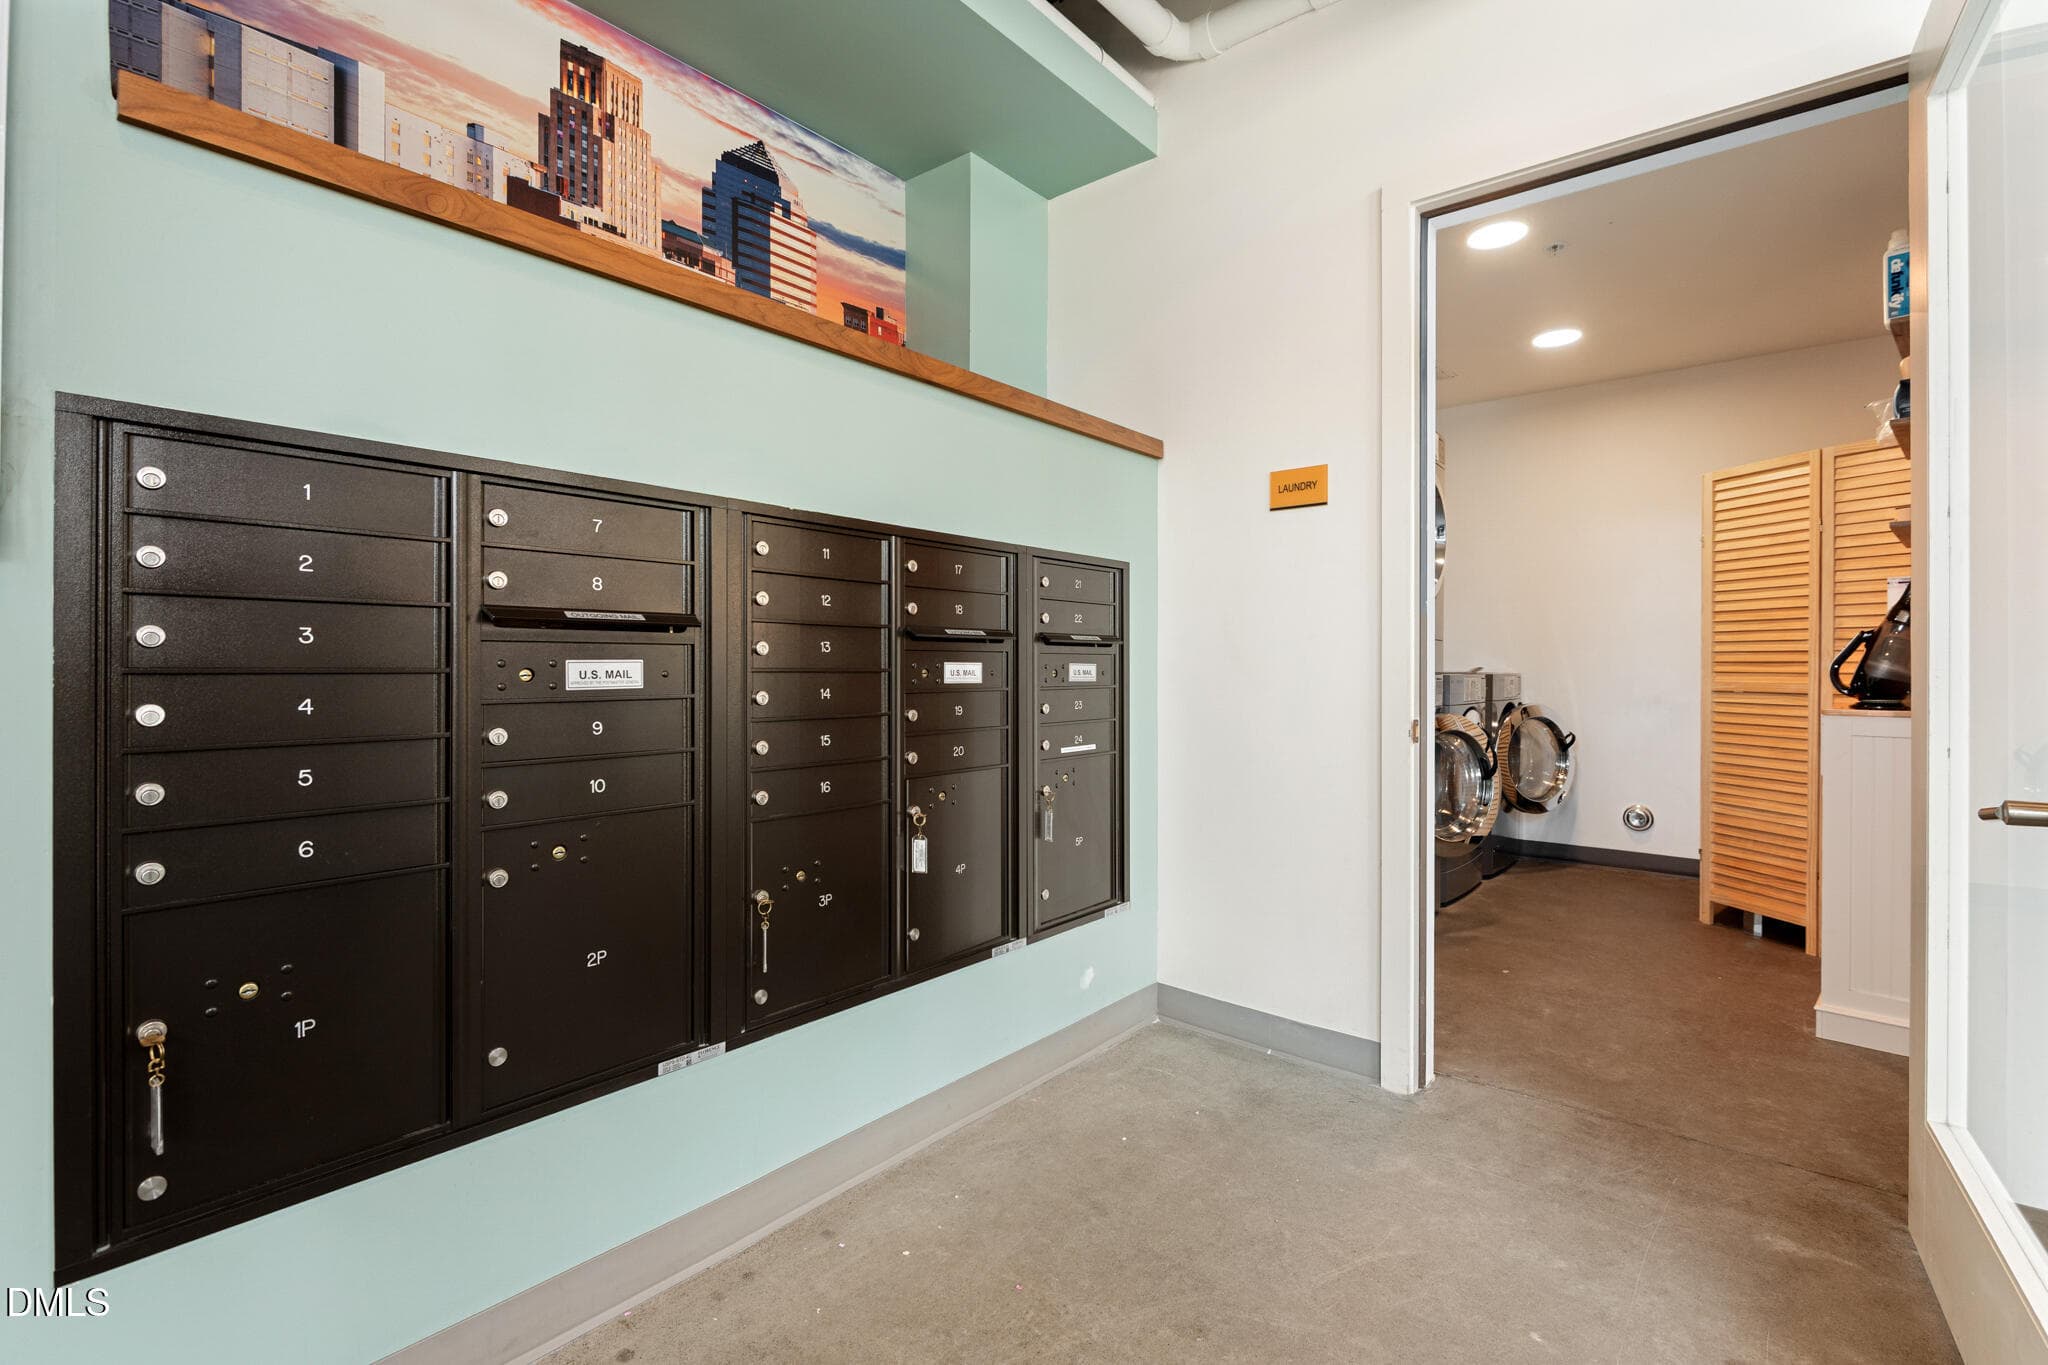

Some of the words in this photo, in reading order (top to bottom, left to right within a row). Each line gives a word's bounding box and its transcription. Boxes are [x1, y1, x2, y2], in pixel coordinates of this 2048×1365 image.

[303, 483, 311, 501] 1
[1278, 480, 1318, 494] LAUNDRY
[592, 518, 603, 533] 7
[822, 547, 830, 560] 11
[298, 554, 314, 573] 2
[954, 564, 963, 575] 17
[592, 576, 603, 591] 8
[1074, 579, 1083, 589] 21
[821, 594, 832, 607] 12
[954, 604, 964, 615] 18
[1074, 613, 1083, 624] 22
[298, 626, 314, 644] 3
[820, 641, 831, 653] 13
[578, 669, 602, 680] U.S.
[605, 669, 633, 680] MAIL
[950, 669, 962, 677] U.S.
[962, 669, 977, 677] MAIL
[820, 688, 831, 700] 14
[297, 698, 314, 715] 4
[954, 705, 963, 716] 19
[1074, 700, 1083, 710] 23
[592, 720, 603, 736] 9
[820, 734, 831, 747] 15
[1073, 734, 1083, 745] 24
[953, 745, 965, 757] 20
[297, 769, 313, 787] 5
[589, 778, 606, 794] 10
[820, 781, 831, 793] 16
[1074, 836, 1084, 847] 5P
[298, 840, 314, 858] 6
[954, 863, 967, 875] 4P
[817, 892, 833, 908] 3P
[586, 949, 608, 969] 2P
[292, 1018, 316, 1041] 1P
